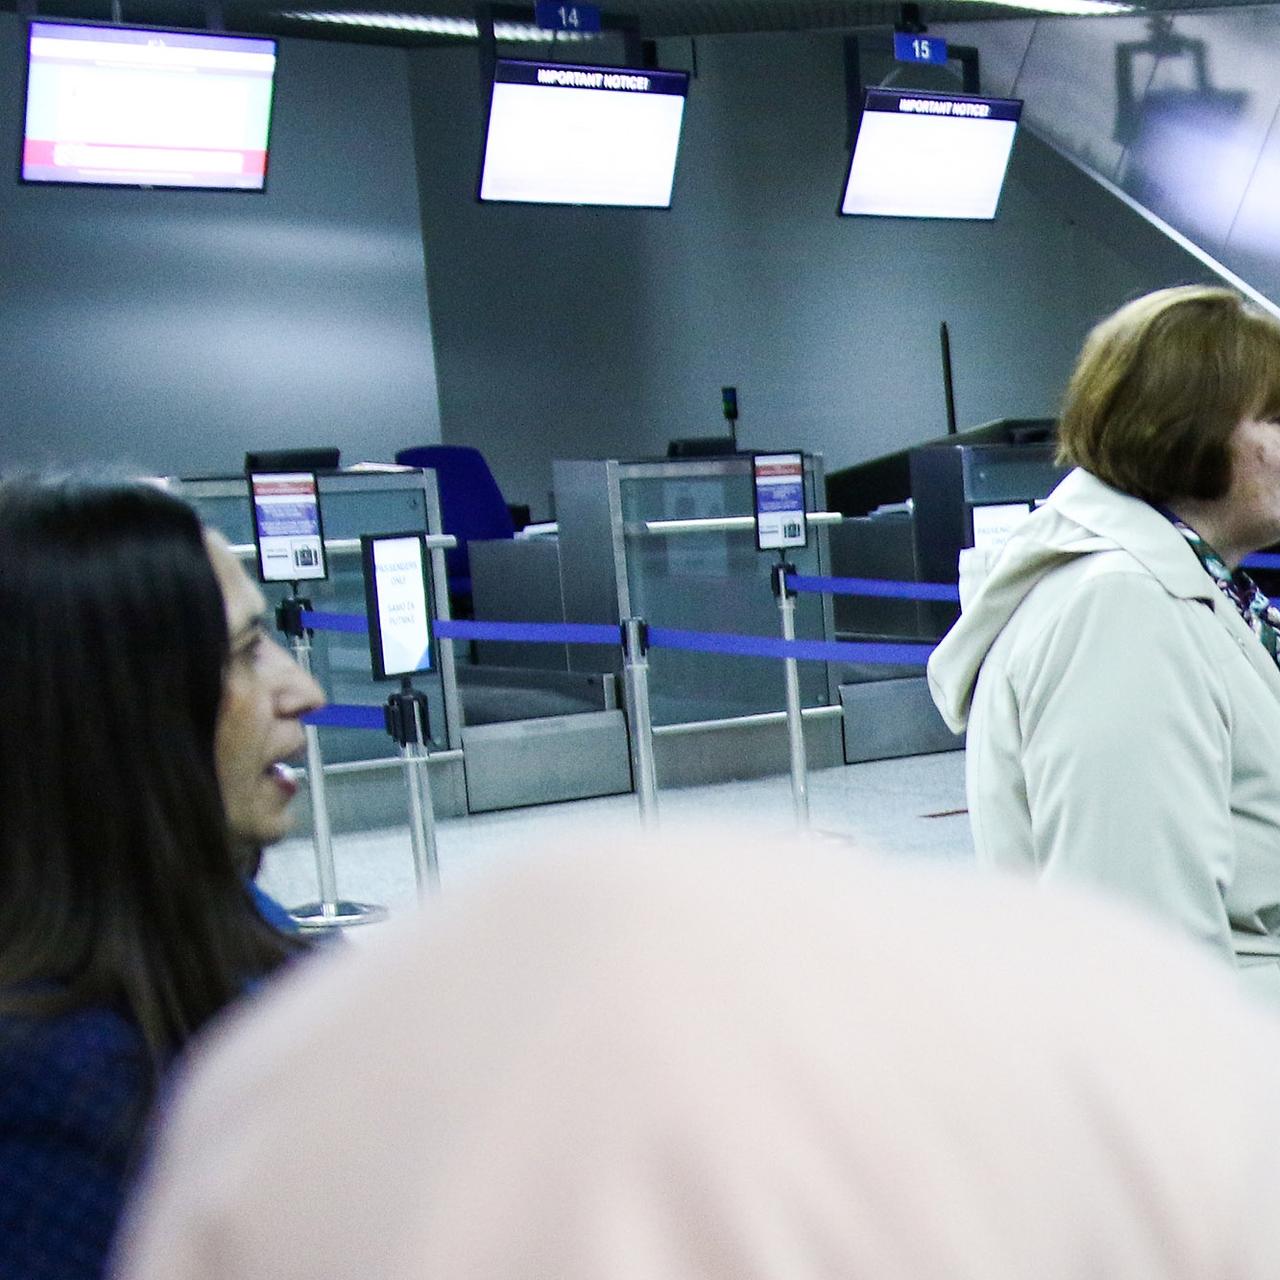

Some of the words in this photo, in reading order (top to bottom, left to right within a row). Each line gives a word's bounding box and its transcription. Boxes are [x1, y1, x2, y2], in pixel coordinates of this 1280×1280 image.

[558, 7, 579, 27] 14
[913, 40, 930, 59] 15
[538, 69, 603, 87] IMPORTANT
[604, 75, 650, 91] NOTICE!
[899, 98, 952, 115] IMPORTANT
[952, 103, 989, 117] NOTICE!
